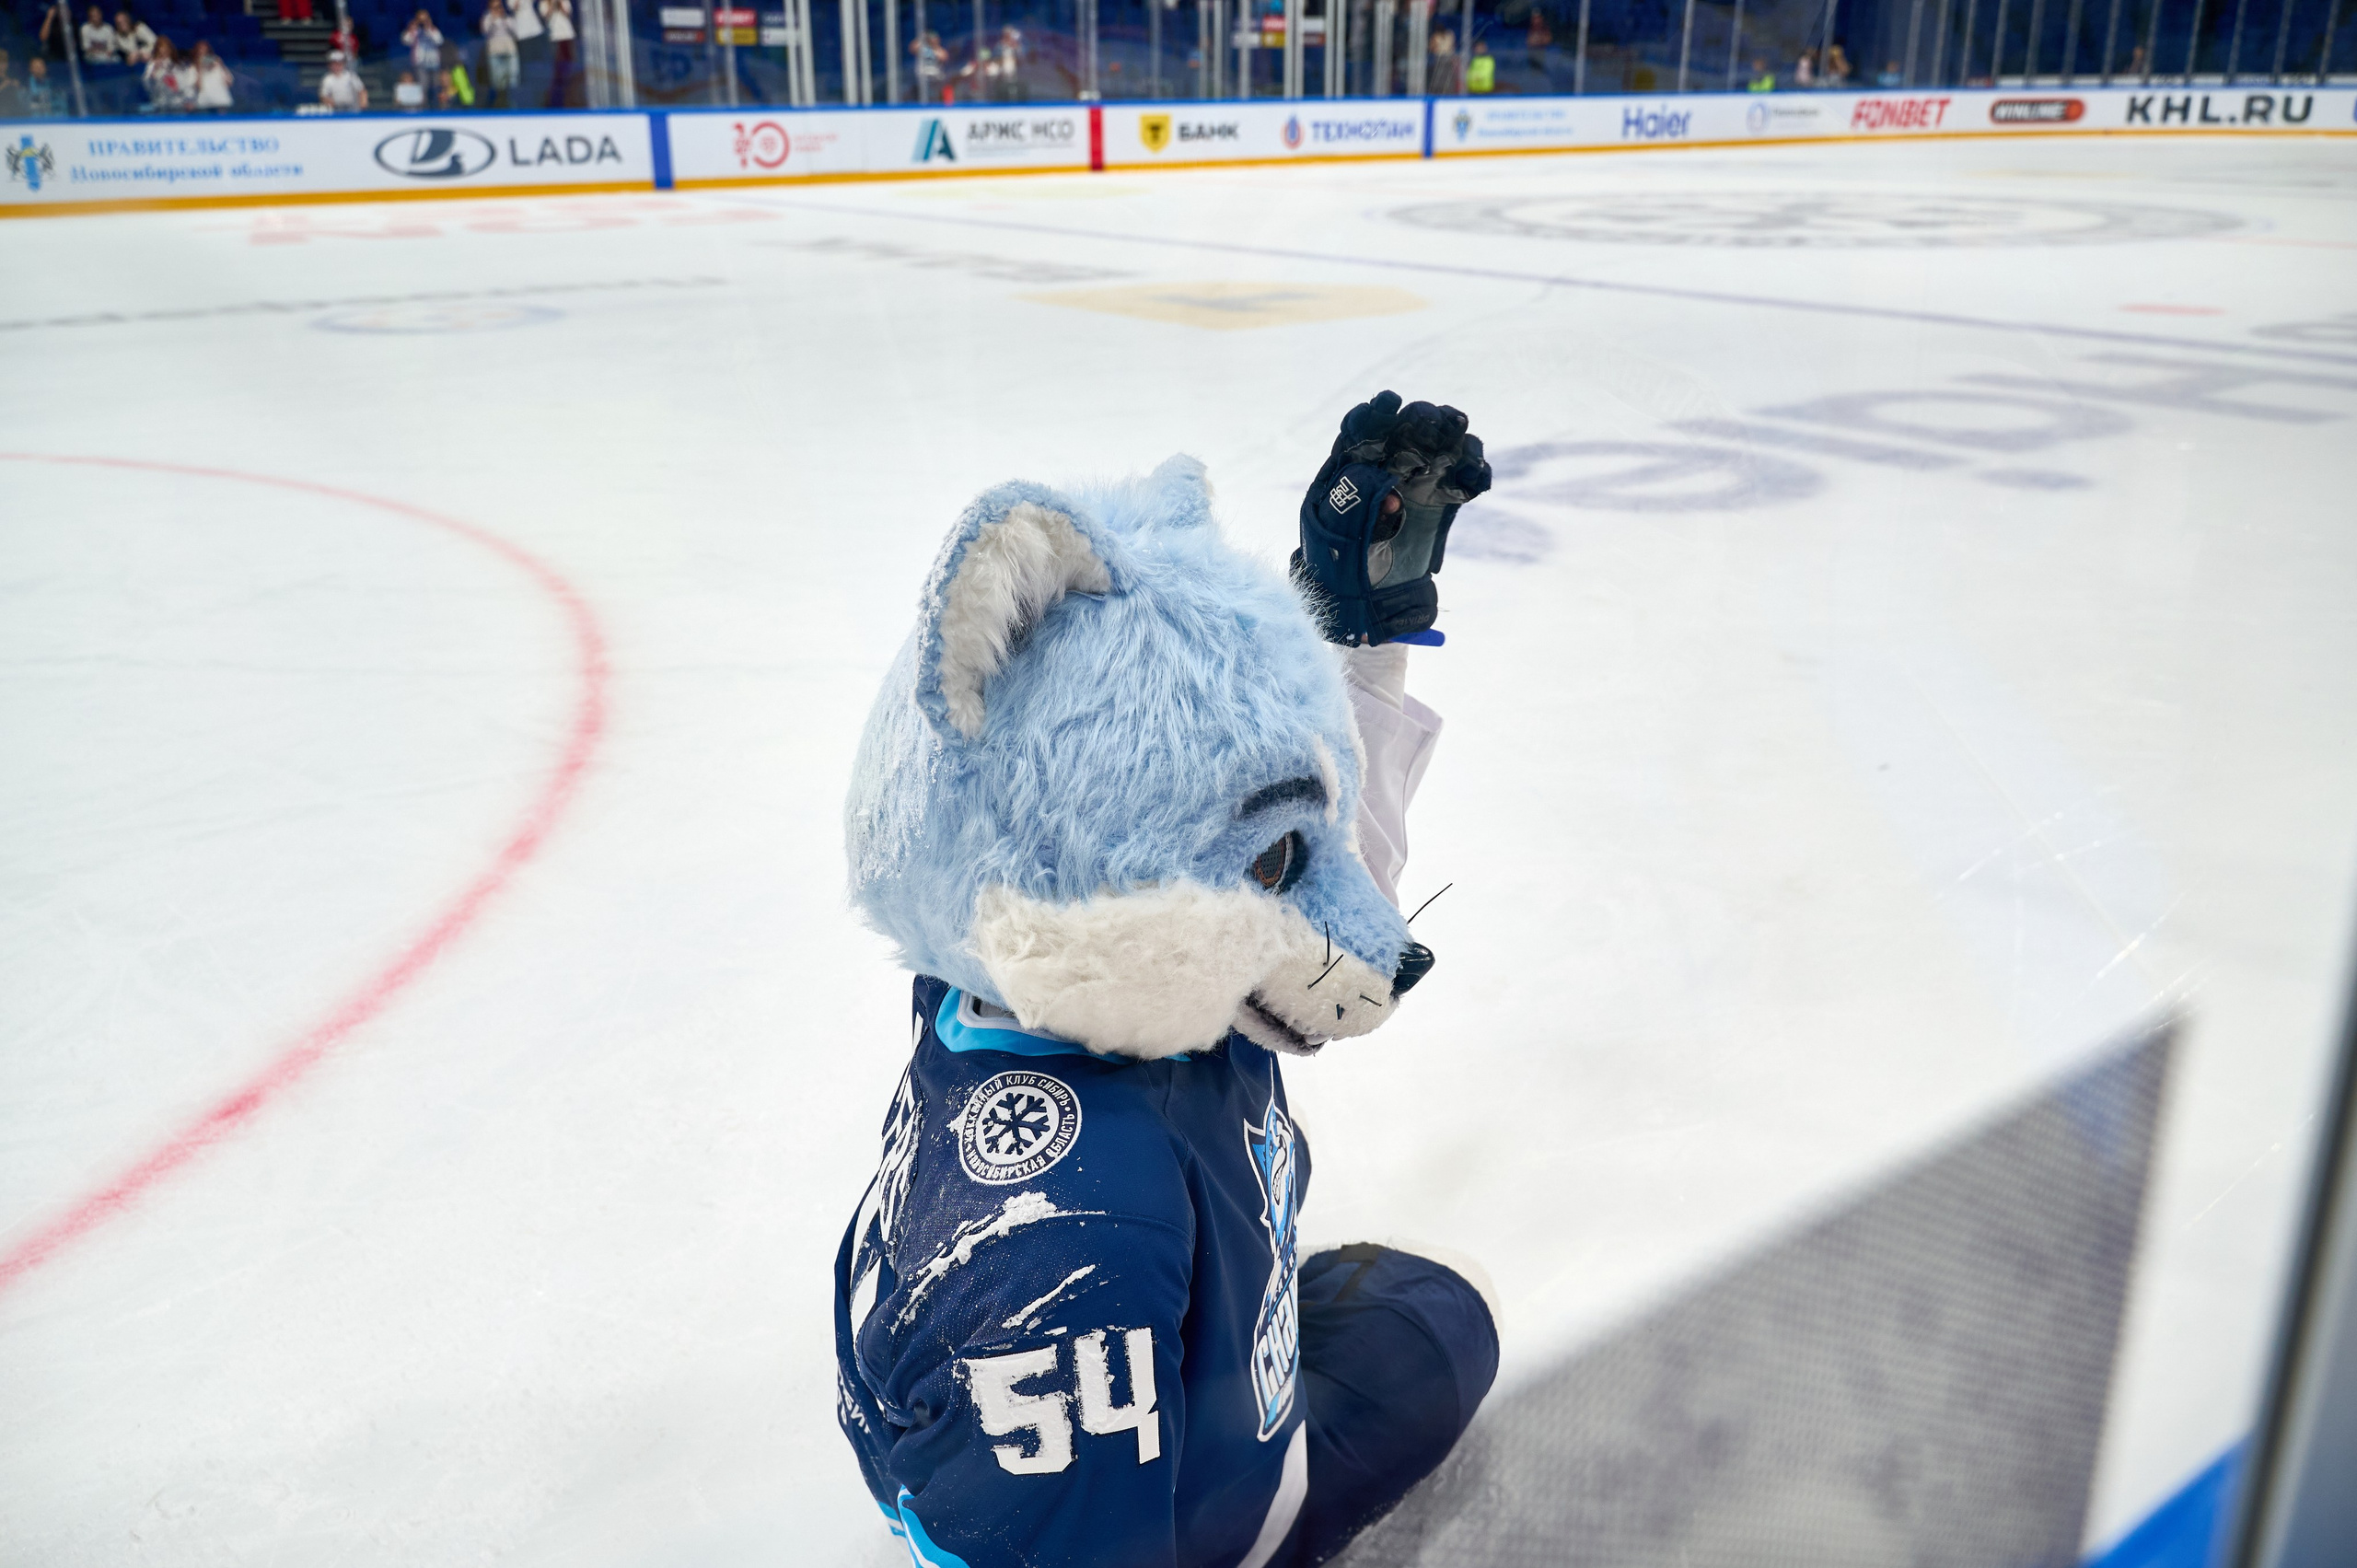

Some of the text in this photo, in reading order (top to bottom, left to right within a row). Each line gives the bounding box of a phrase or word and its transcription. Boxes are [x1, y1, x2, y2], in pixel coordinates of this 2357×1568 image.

[1621, 102, 1692, 139] Haier
[1851, 96, 1952, 131] FONBET
[1994, 100, 2066, 122] WINLINE
[2127, 93, 2313, 123] KHL.RU
[87, 135, 281, 157] ПРАВИТЕЛЬСТВО
[1177, 122, 1239, 143] БАНК
[509, 135, 621, 166] LADA
[70, 162, 304, 184] Новосибирской области
[1006, 1074, 1037, 1086] КЛУБ
[1038, 1078, 1071, 1107] СИБИРЬ
[966, 1113, 1075, 1181] НОВОСИБИРСКАЯ ОБЛАСТЬ
[965, 1326, 1161, 1476] 54
